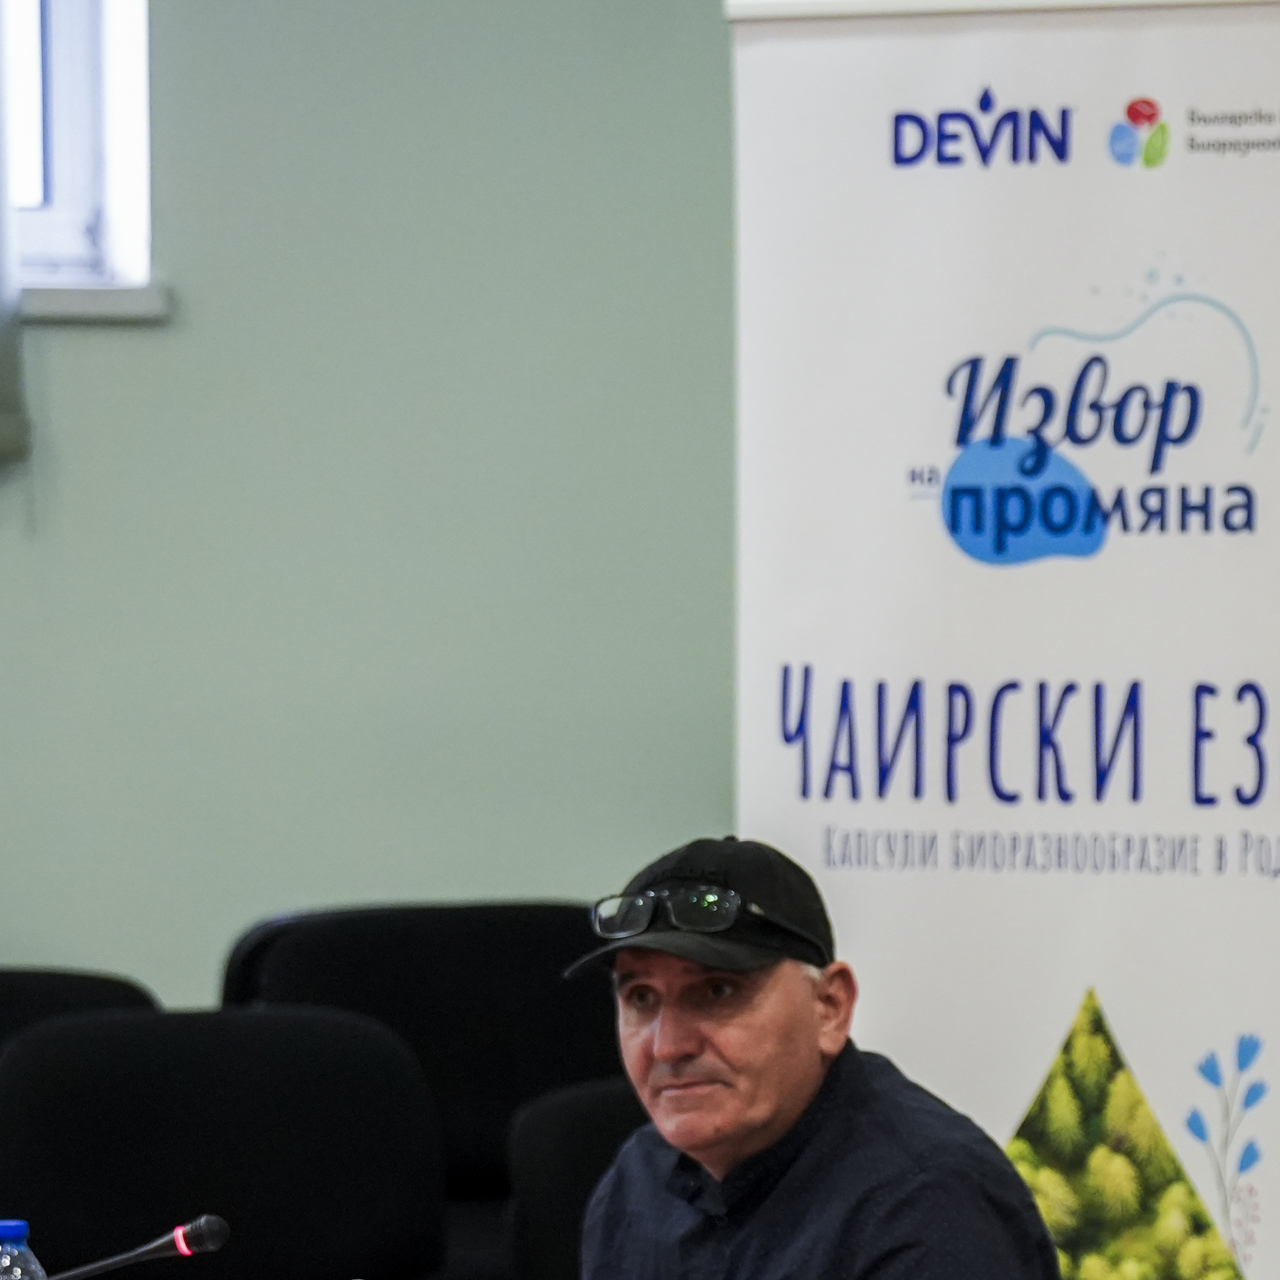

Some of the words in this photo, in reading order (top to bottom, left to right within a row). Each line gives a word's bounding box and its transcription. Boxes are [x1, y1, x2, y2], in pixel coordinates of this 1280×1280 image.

[892, 107, 1072, 168] DEVIN
[946, 354, 1202, 477] Извор
[908, 465, 940, 485] на
[950, 484, 1257, 556] промяна
[779, 664, 1142, 805] ЧАИРСКИ
